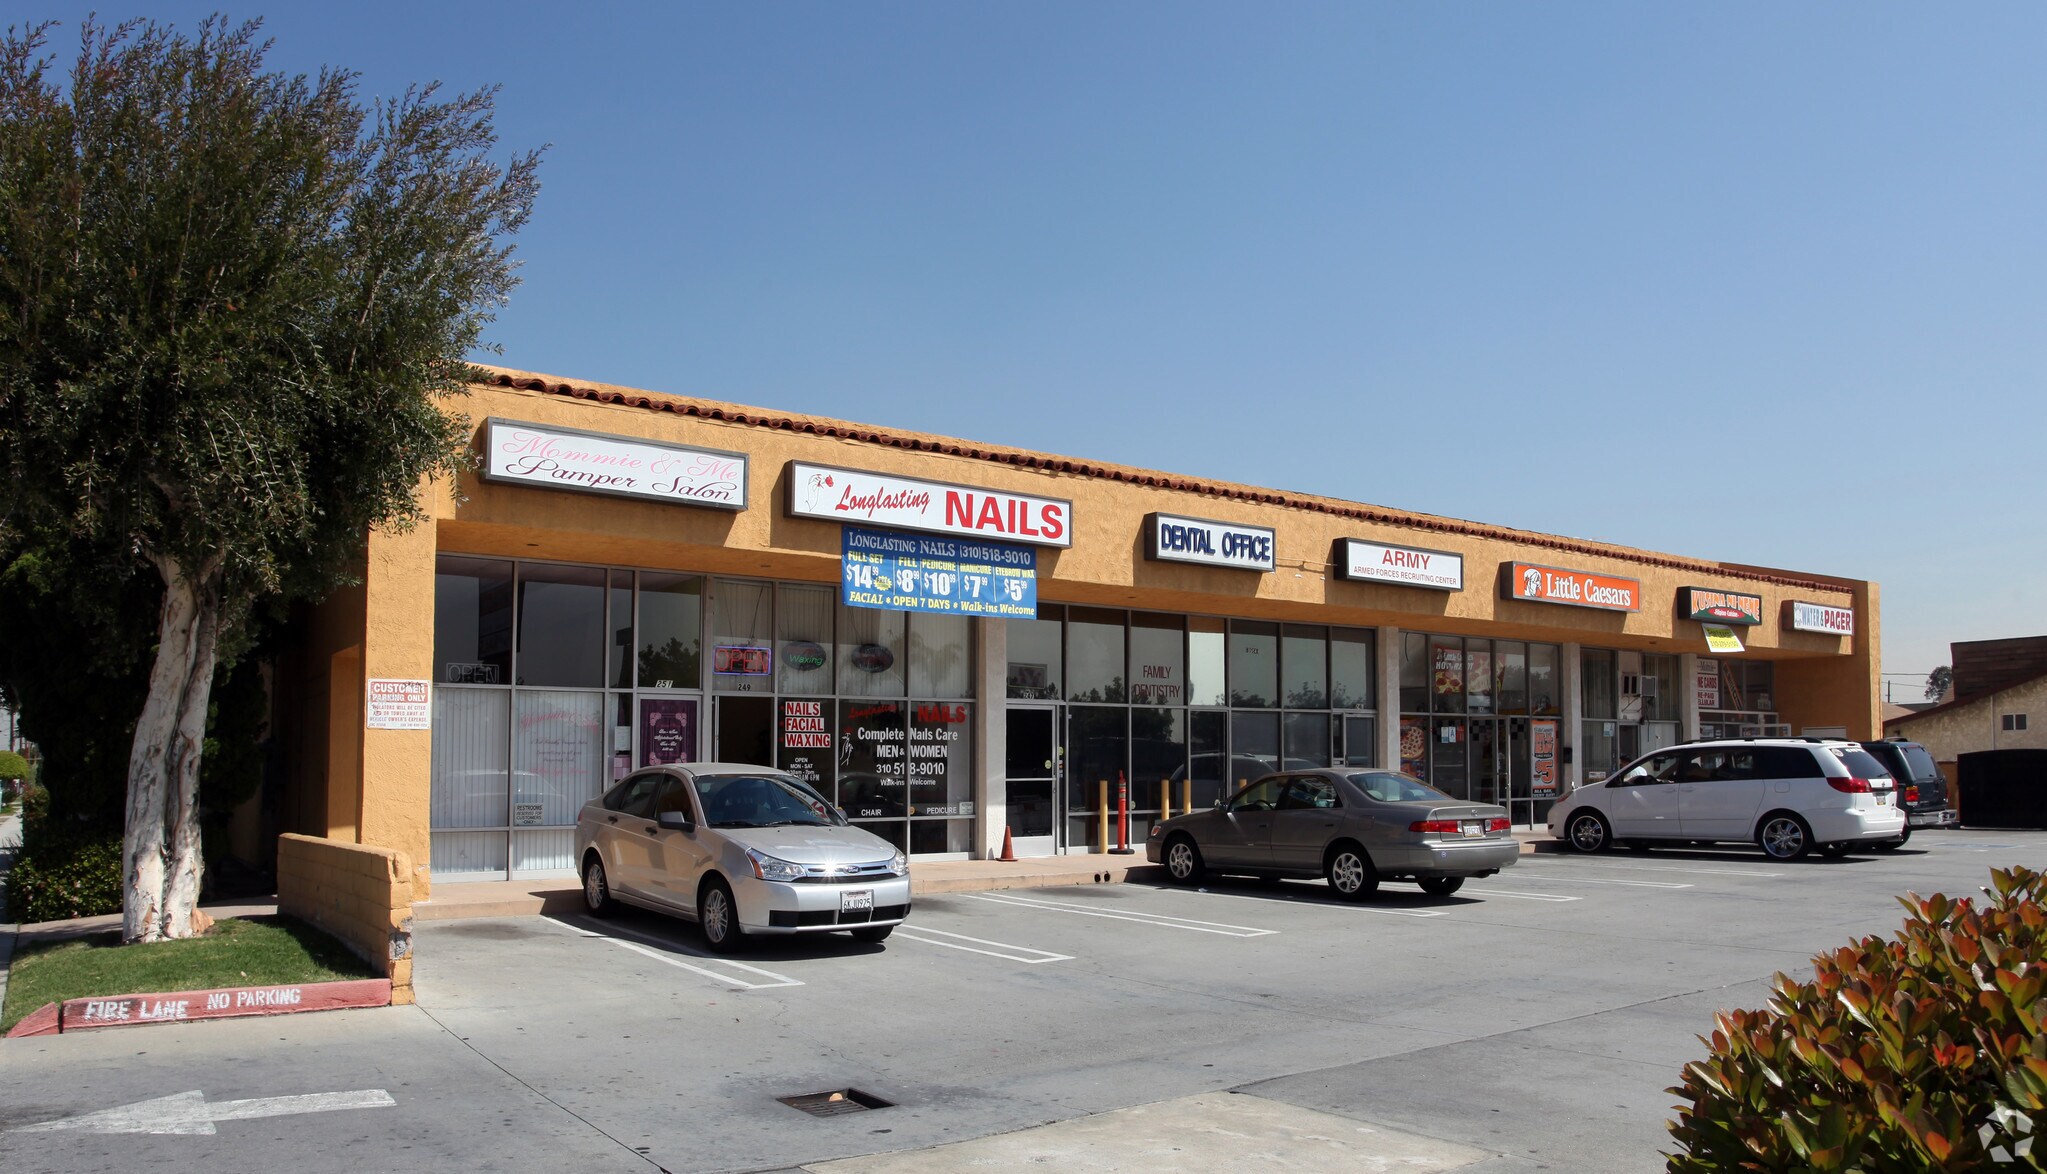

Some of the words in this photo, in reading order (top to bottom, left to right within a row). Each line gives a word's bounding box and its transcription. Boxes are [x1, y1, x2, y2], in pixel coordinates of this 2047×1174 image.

[502, 432, 642, 469] Mommie
[650, 452, 681, 476] &
[687, 456, 739, 481] Me
[506, 455, 638, 488] Pamper
[652, 476, 738, 501] Salon
[835, 484, 930, 518] Longlasting
[945, 490, 1064, 539] NAILS
[849, 532, 916, 553] LONGLASTING
[920, 541, 955, 560] NAILS
[1161, 523, 1215, 555] DENTAL
[1221, 532, 1270, 561] OFFICE
[848, 551, 867, 563] FULL
[870, 553, 884, 565] SET
[899, 556, 917, 568] FILL
[922, 559, 956, 572] PEDICURE
[959, 562, 992, 575] MANICURE
[1021, 568, 1035, 579] WAX
[1382, 549, 1430, 571] ARMY
[1353, 566, 1375, 577] ARMED
[1376, 568, 1399, 580] FORCES
[1400, 571, 1433, 584] RECRUITING
[1434, 575, 1456, 586] CENTER
[1545, 572, 1581, 600] Little
[1583, 579, 1631, 607] Caesars
[849, 591, 883, 606] FACIAL
[893, 595, 918, 608] OPEN
[921, 597, 925, 608] 7
[928, 598, 950, 610] DAYS
[960, 600, 998, 613] Walk-ins
[999, 603, 1035, 616] Welcome
[1691, 590, 1726, 615] KUSINA
[1726, 594, 1737, 610] NI
[1737, 596, 1760, 622] NENE
[1802, 607, 1820, 627] WATER
[1820, 611, 1824, 627] &
[1824, 610, 1851, 631] PAGER
[715, 648, 768, 673] OPEN
[790, 653, 823, 666] Waxing
[449, 664, 497, 684] OPEN
[1143, 665, 1172, 679] FAMILY
[656, 680, 673, 688] 251
[738, 683, 751, 691] 249
[1134, 684, 1180, 698] DENTISTRY
[407, 694, 426, 702] ONLY
[786, 702, 820, 716] NAILS
[917, 704, 967, 723] NAILS
[786, 718, 824, 731] FACIAL
[786, 733, 830, 747] WAXING
[857, 727, 904, 743] Complete
[910, 728, 933, 741] Nails
[935, 728, 957, 741] Care
[876, 745, 898, 758] MEN
[910, 745, 948, 758] WOMEN
[876, 764, 891, 774] 310
[893, 762, 945, 775] 518-9010
[1535, 759, 1554, 784] $5
[910, 778, 936, 786] Welcome
[927, 807, 957, 815] PEDICURE
[85, 1000, 132, 1020] FIRE
[140, 1000, 189, 1019] LANE
[207, 993, 230, 1011] NO
[236, 989, 301, 1008] PARKING
